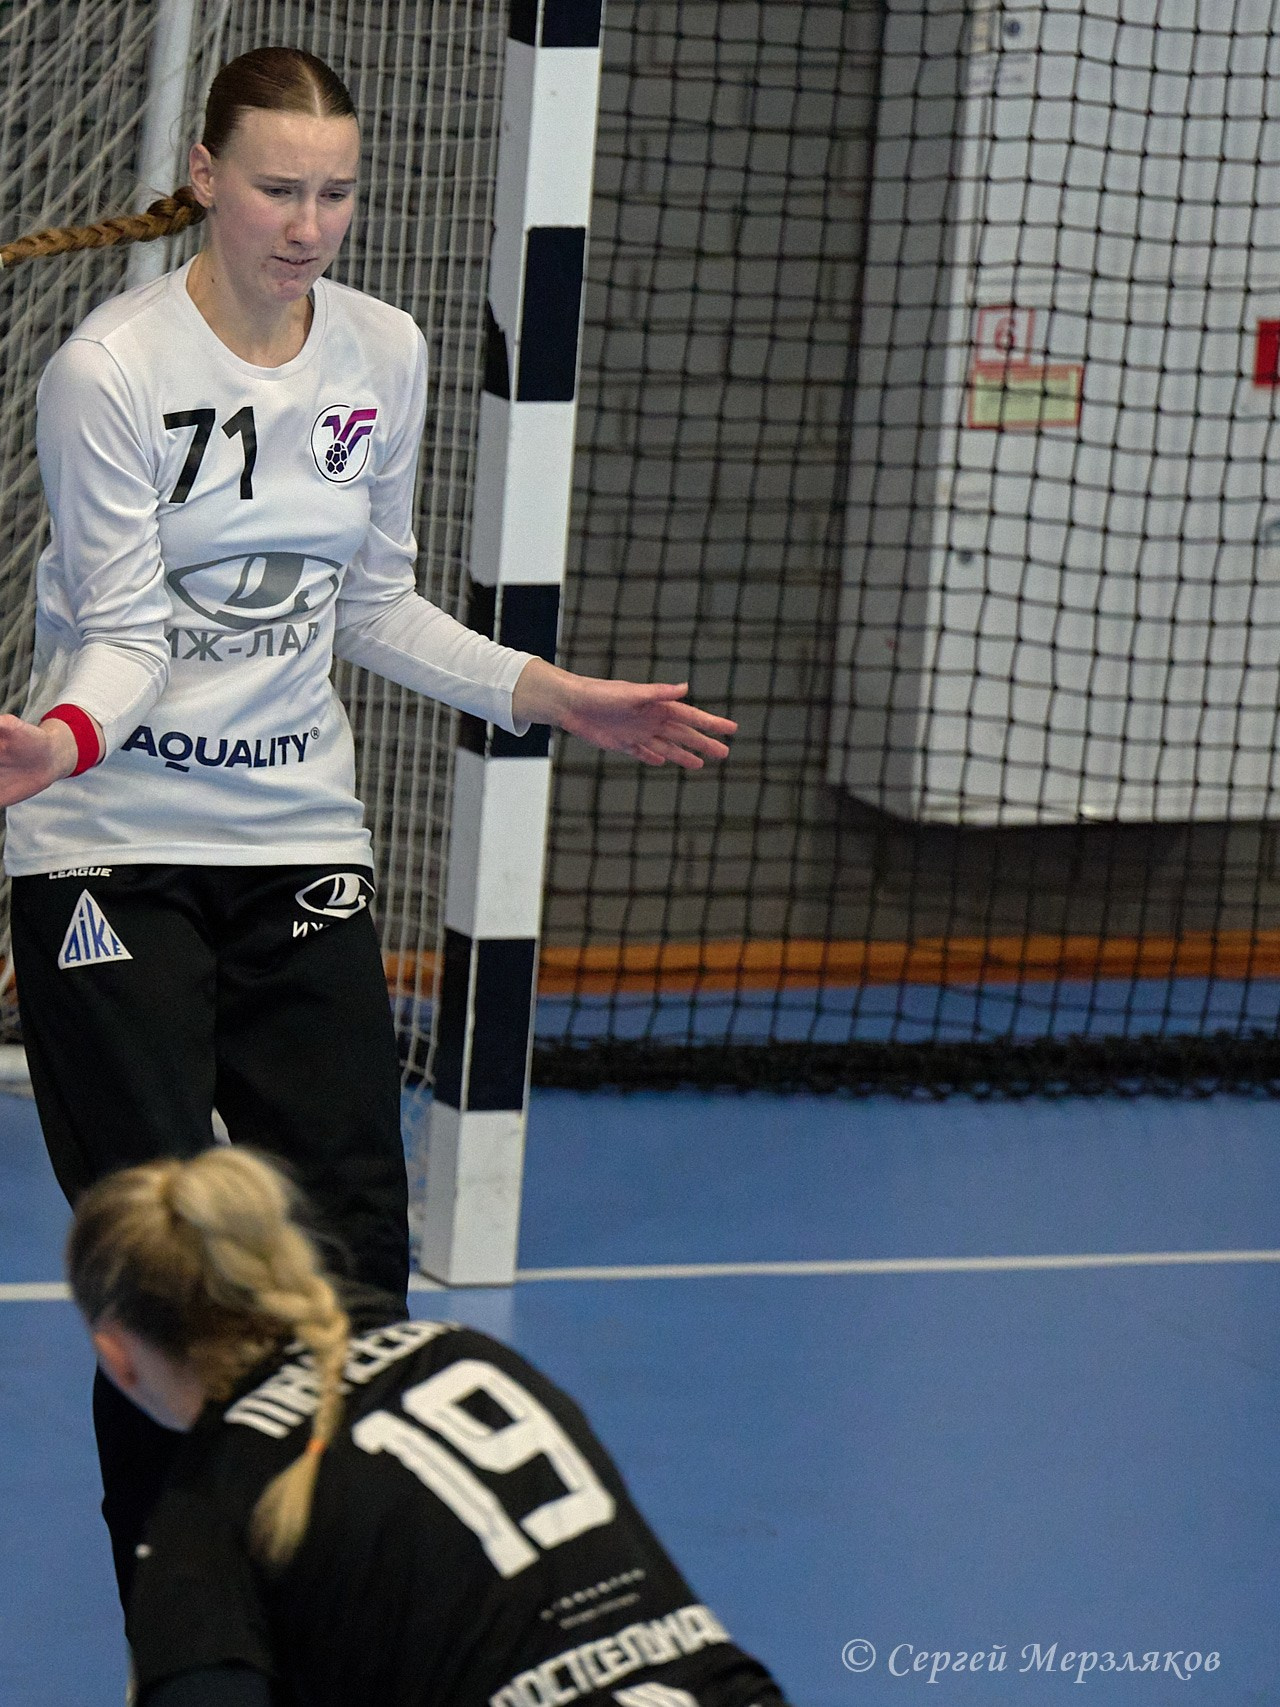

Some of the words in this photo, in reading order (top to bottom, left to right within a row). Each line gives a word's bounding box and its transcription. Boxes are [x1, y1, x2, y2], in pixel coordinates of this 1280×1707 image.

[163, 406, 258, 504] 71
[48, 866, 113, 880] LEAGUE
[352, 1359, 616, 1579] 19
